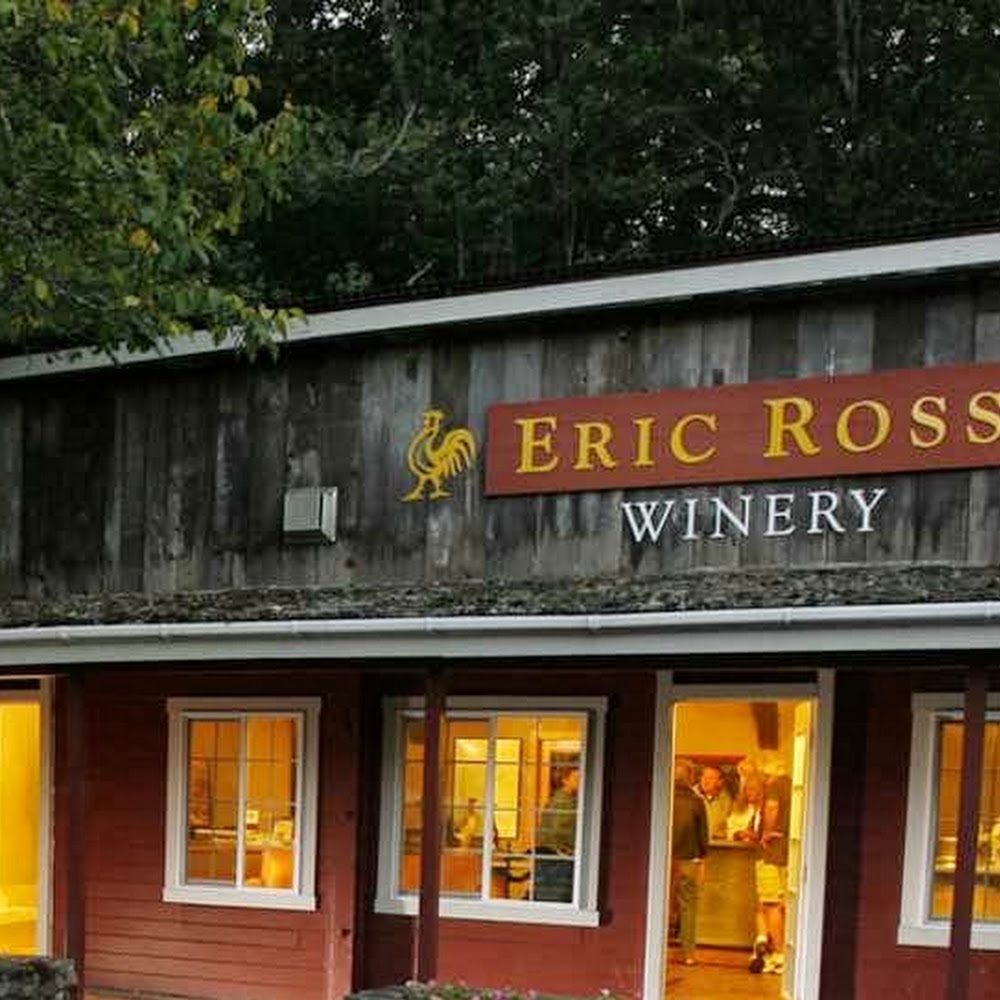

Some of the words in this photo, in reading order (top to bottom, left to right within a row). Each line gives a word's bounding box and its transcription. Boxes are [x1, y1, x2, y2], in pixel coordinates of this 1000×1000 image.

[514, 414, 718, 473] ERIC
[762, 391, 1000, 458] ROSS
[622, 488, 887, 543] WINERY
